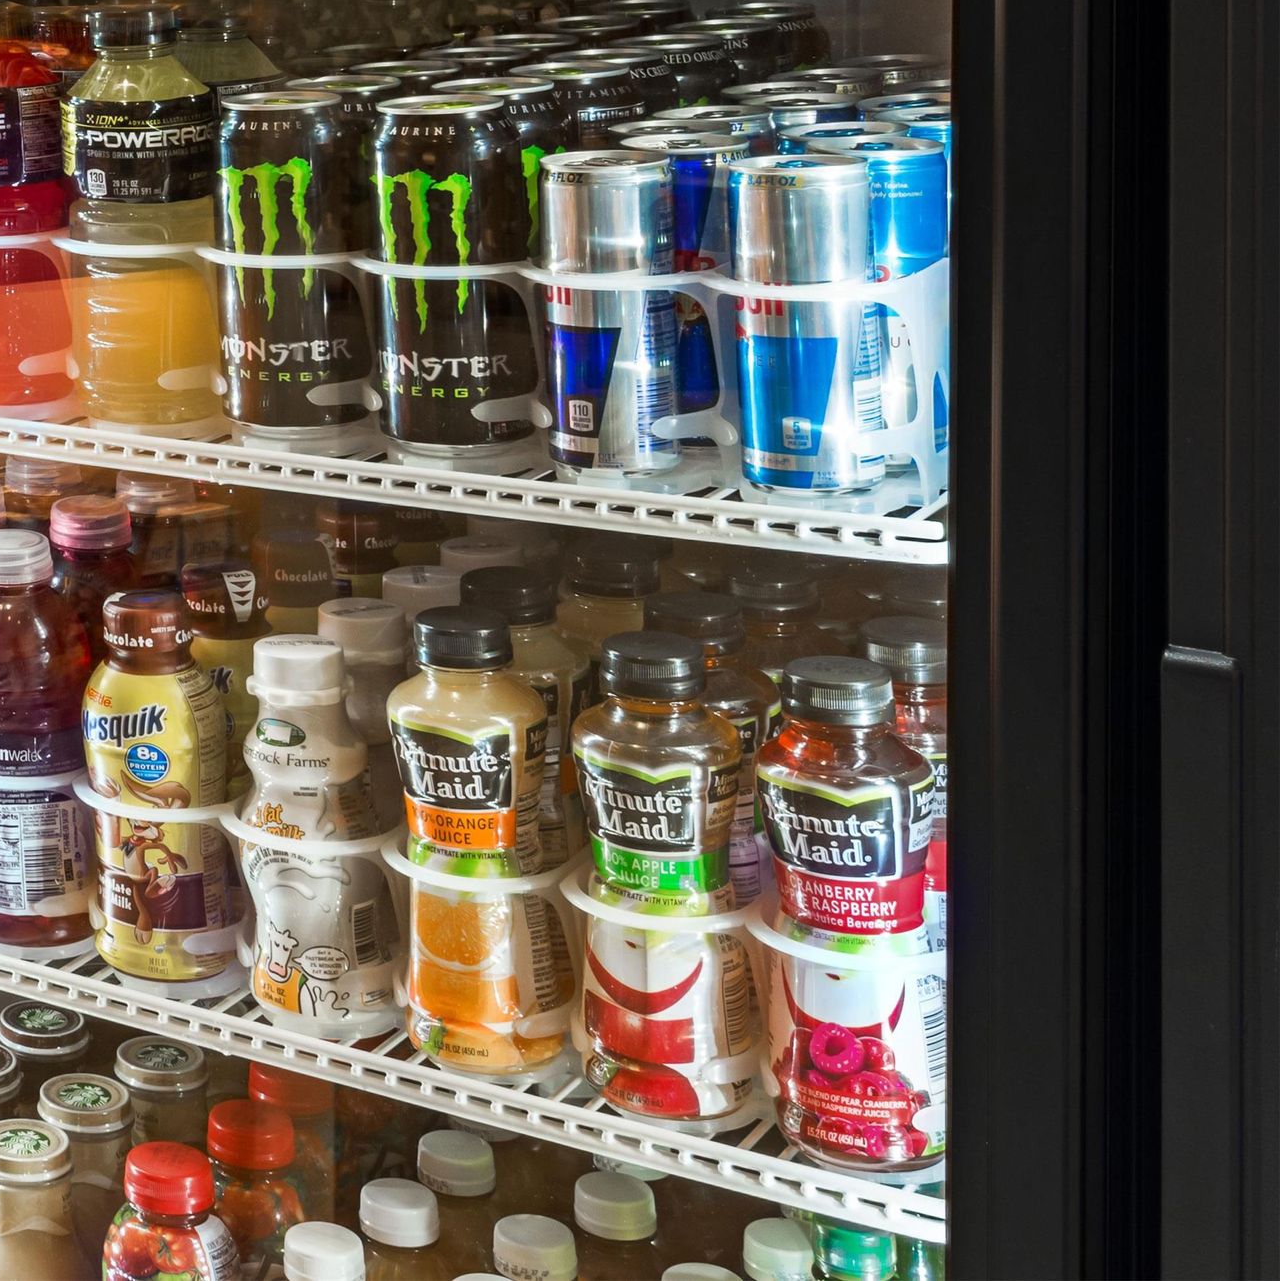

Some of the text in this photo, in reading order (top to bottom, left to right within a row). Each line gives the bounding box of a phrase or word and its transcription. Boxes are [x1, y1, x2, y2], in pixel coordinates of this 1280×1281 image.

[86, 123, 216, 149] POWERADE
[86, 149, 110, 159] SPORTS
[111, 151, 134, 159] DRINK
[136, 150, 155, 159] WITH
[228, 365, 331, 382] ENERGY
[382, 379, 490, 399] ENERGY
[274, 568, 328, 583] Chocolate
[82, 704, 168, 748] Nesquik
[129, 761, 166, 771] PROTEIN
[136, 746, 158, 762] 8g
[395, 734, 499, 774] Minute
[411, 771, 486, 800] Maid
[583, 770, 683, 814] Minute
[435, 814, 495, 830] ORANGE
[598, 809, 672, 841] Maid
[762, 792, 886, 838] Minute
[431, 828, 472, 845] JUICE
[780, 825, 867, 867] Maid
[615, 870, 661, 888] JUICE
[789, 874, 875, 902] CRANBERRY
[780, 883, 898, 918] APPE RASPBERRY
[809, 1089, 908, 1111] BLEND OF PEAR, CRANBERRY,
